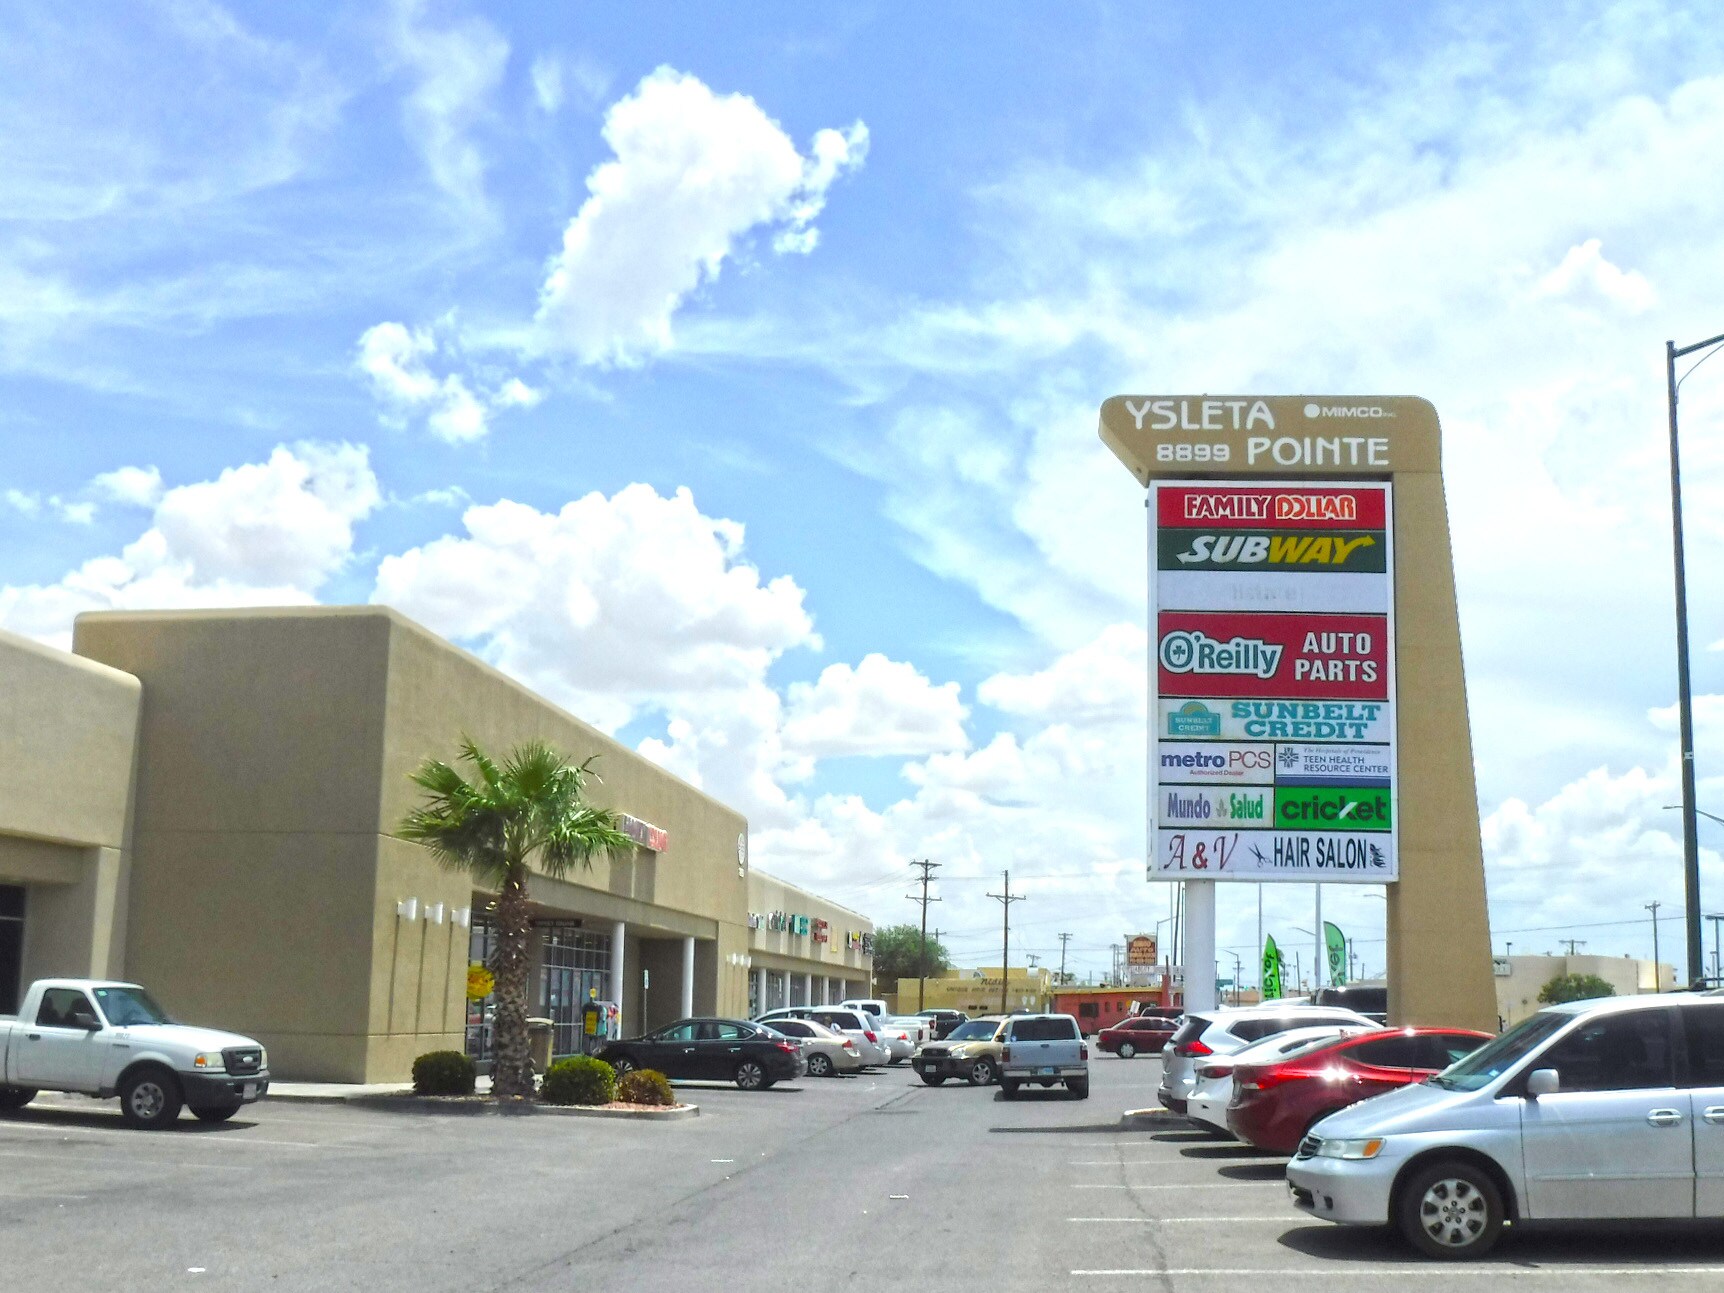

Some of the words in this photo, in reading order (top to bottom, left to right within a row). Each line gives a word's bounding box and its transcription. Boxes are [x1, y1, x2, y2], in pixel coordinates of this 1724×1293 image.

[1126, 400, 1275, 430] YSLETA
[1322, 406, 1382, 418] MIMCO
[1156, 444, 1230, 462] 8899
[1247, 438, 1389, 466] POINTE
[1184, 494, 1271, 520] FAMILY
[1275, 494, 1356, 520] DOLLAR
[1176, 534, 1376, 565] SUBWAY
[1164, 633, 1277, 674] O'Reilly
[1302, 632, 1372, 654] AUTO
[1295, 659, 1378, 682] PARTS
[1232, 702, 1381, 721] SUNBELT
[1244, 721, 1368, 739] CREDIT
[1304, 755, 1326, 763] TEEN
[1329, 756, 1365, 764] HEALTH
[1168, 792, 1210, 819] Mundo
[1230, 793, 1263, 819] Salud
[1281, 794, 1387, 821] cricket
[1164, 833, 1187, 870] A
[1192, 841, 1208, 870] &
[1213, 833, 1238, 871] V
[1274, 836, 1310, 868] HAIR
[1316, 837, 1366, 869] SALON
